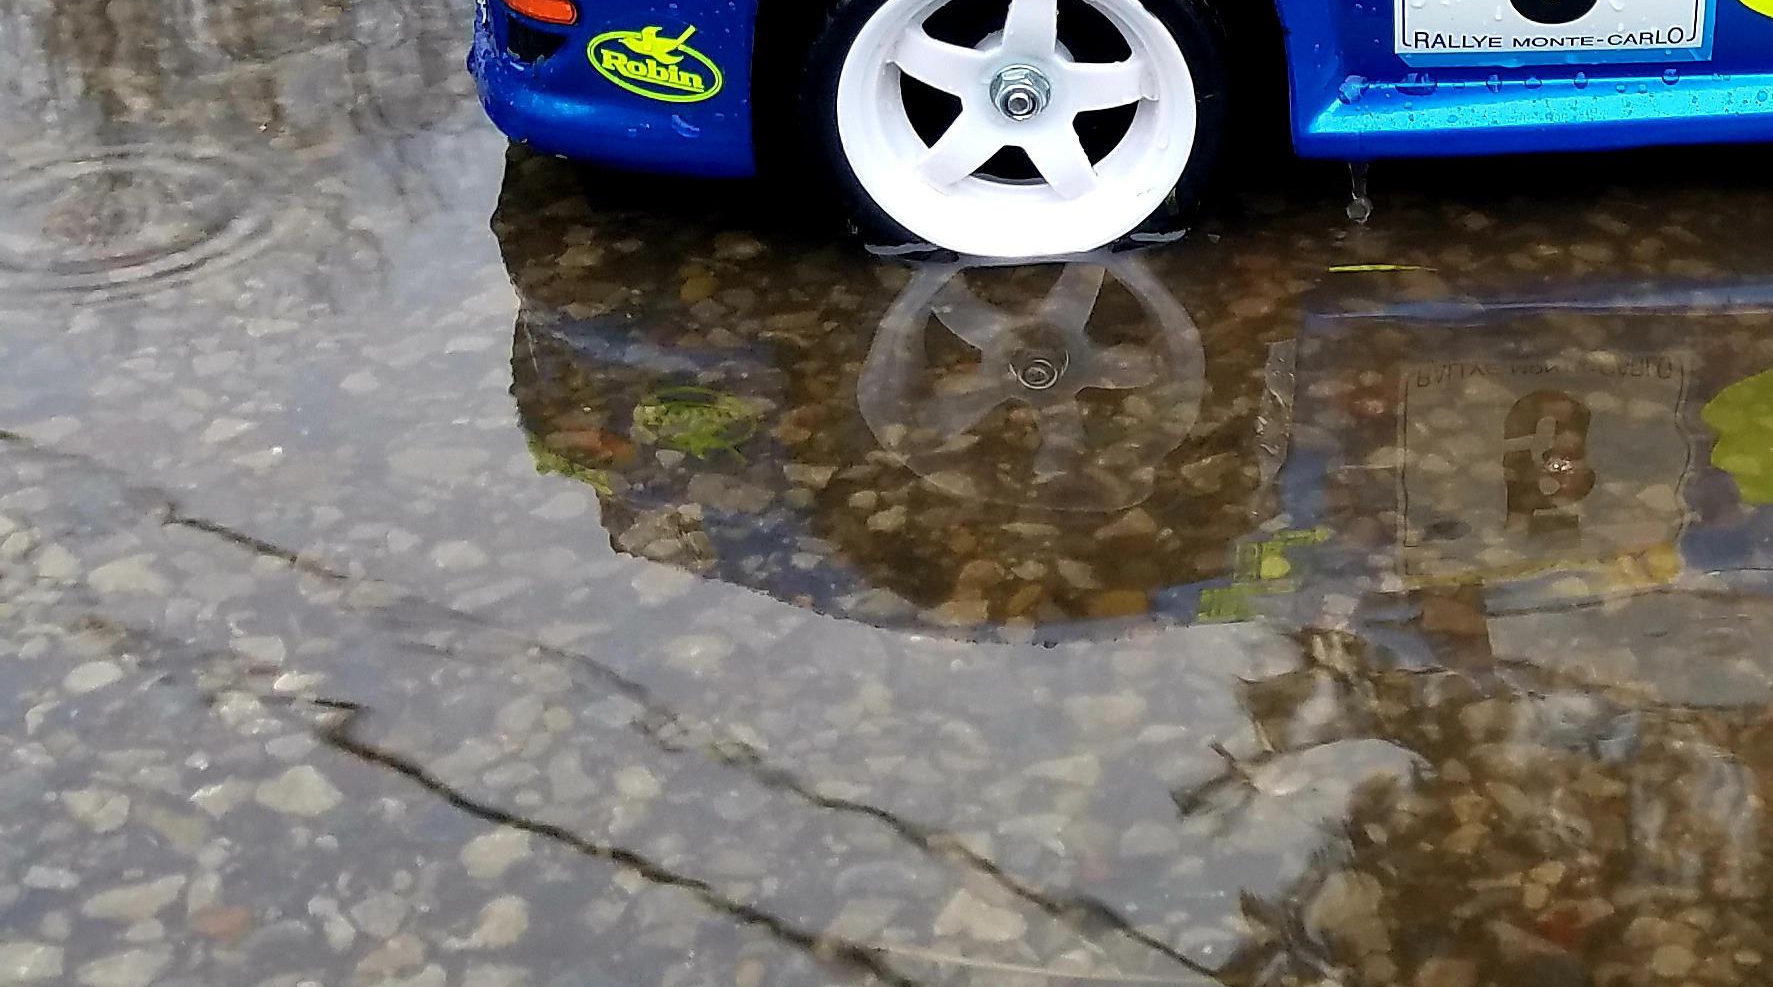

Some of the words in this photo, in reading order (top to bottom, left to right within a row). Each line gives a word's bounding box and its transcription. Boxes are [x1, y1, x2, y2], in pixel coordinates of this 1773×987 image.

[1413, 31, 1503, 49] RALLYE
[1511, 26, 1684, 48] MONTE-CARLO
[600, 48, 705, 92] Robin
